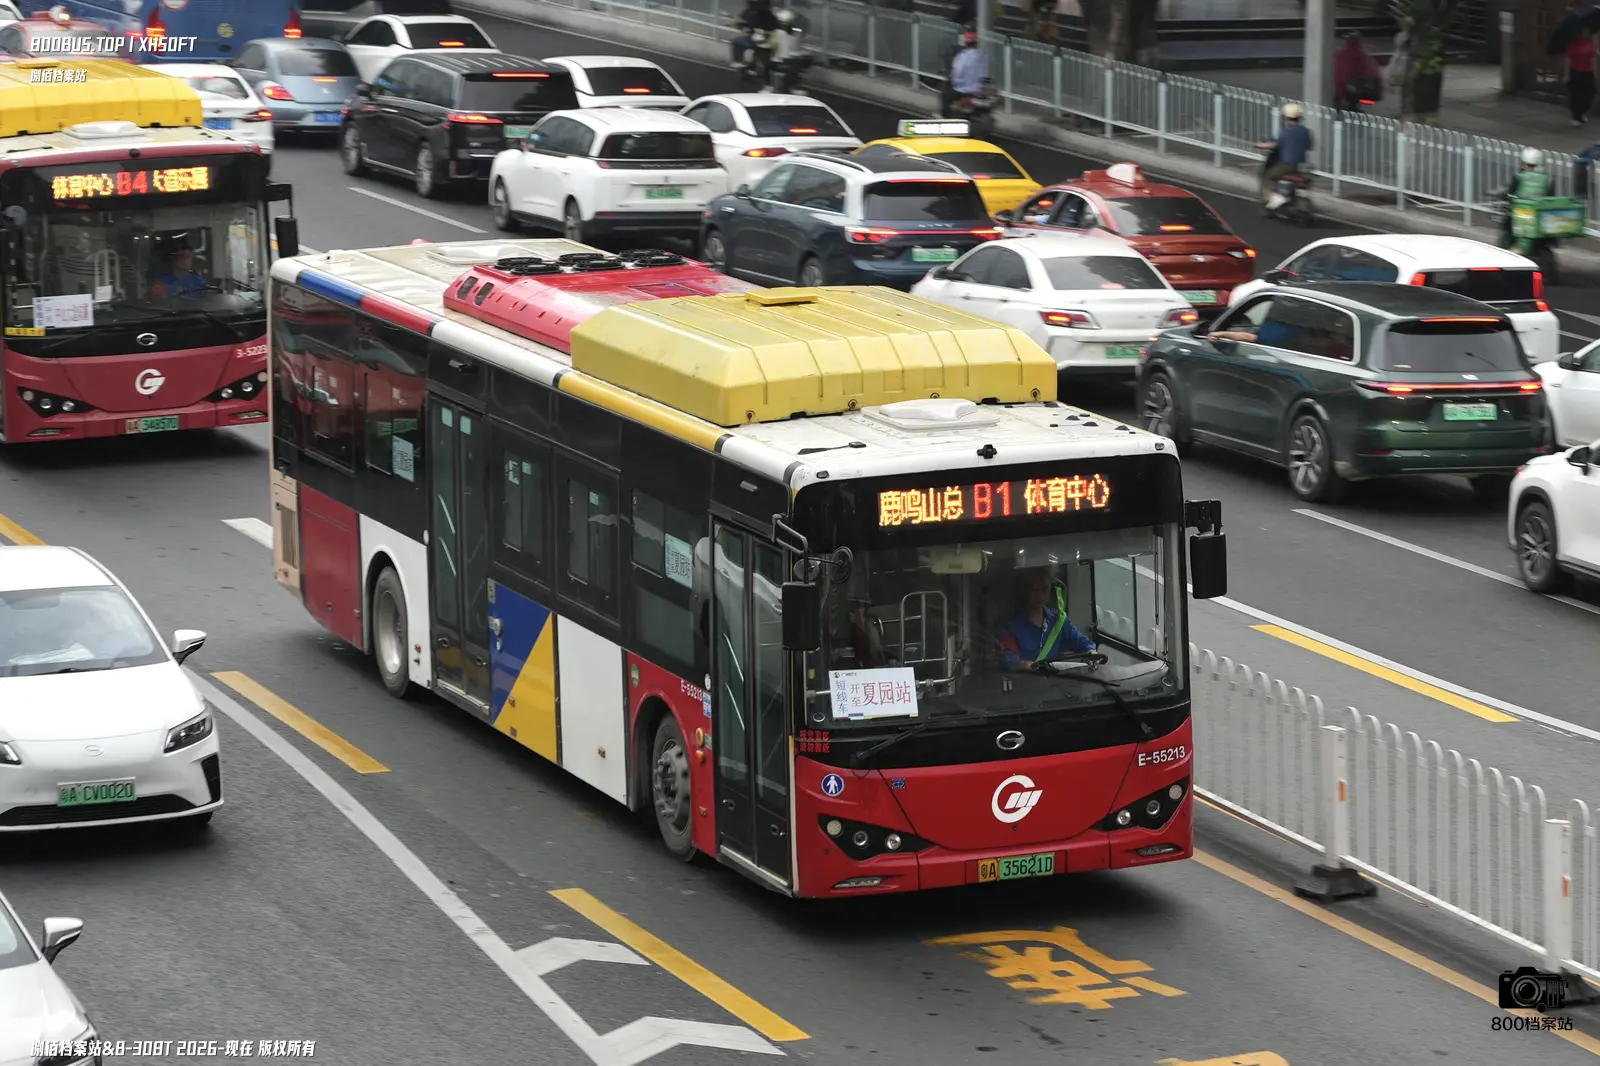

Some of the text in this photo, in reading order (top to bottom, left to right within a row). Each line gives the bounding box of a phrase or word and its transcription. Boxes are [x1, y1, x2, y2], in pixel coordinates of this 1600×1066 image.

[115, 170, 148, 192] B4
[878, 473, 1110, 527] 鹿鸣山总 B1 体育中心
[835, 680, 848, 714] 短线车
[861, 680, 911, 706] 夏园站
[1138, 745, 1186, 767] E-55213
[1003, 856, 1054, 877] 35621D
